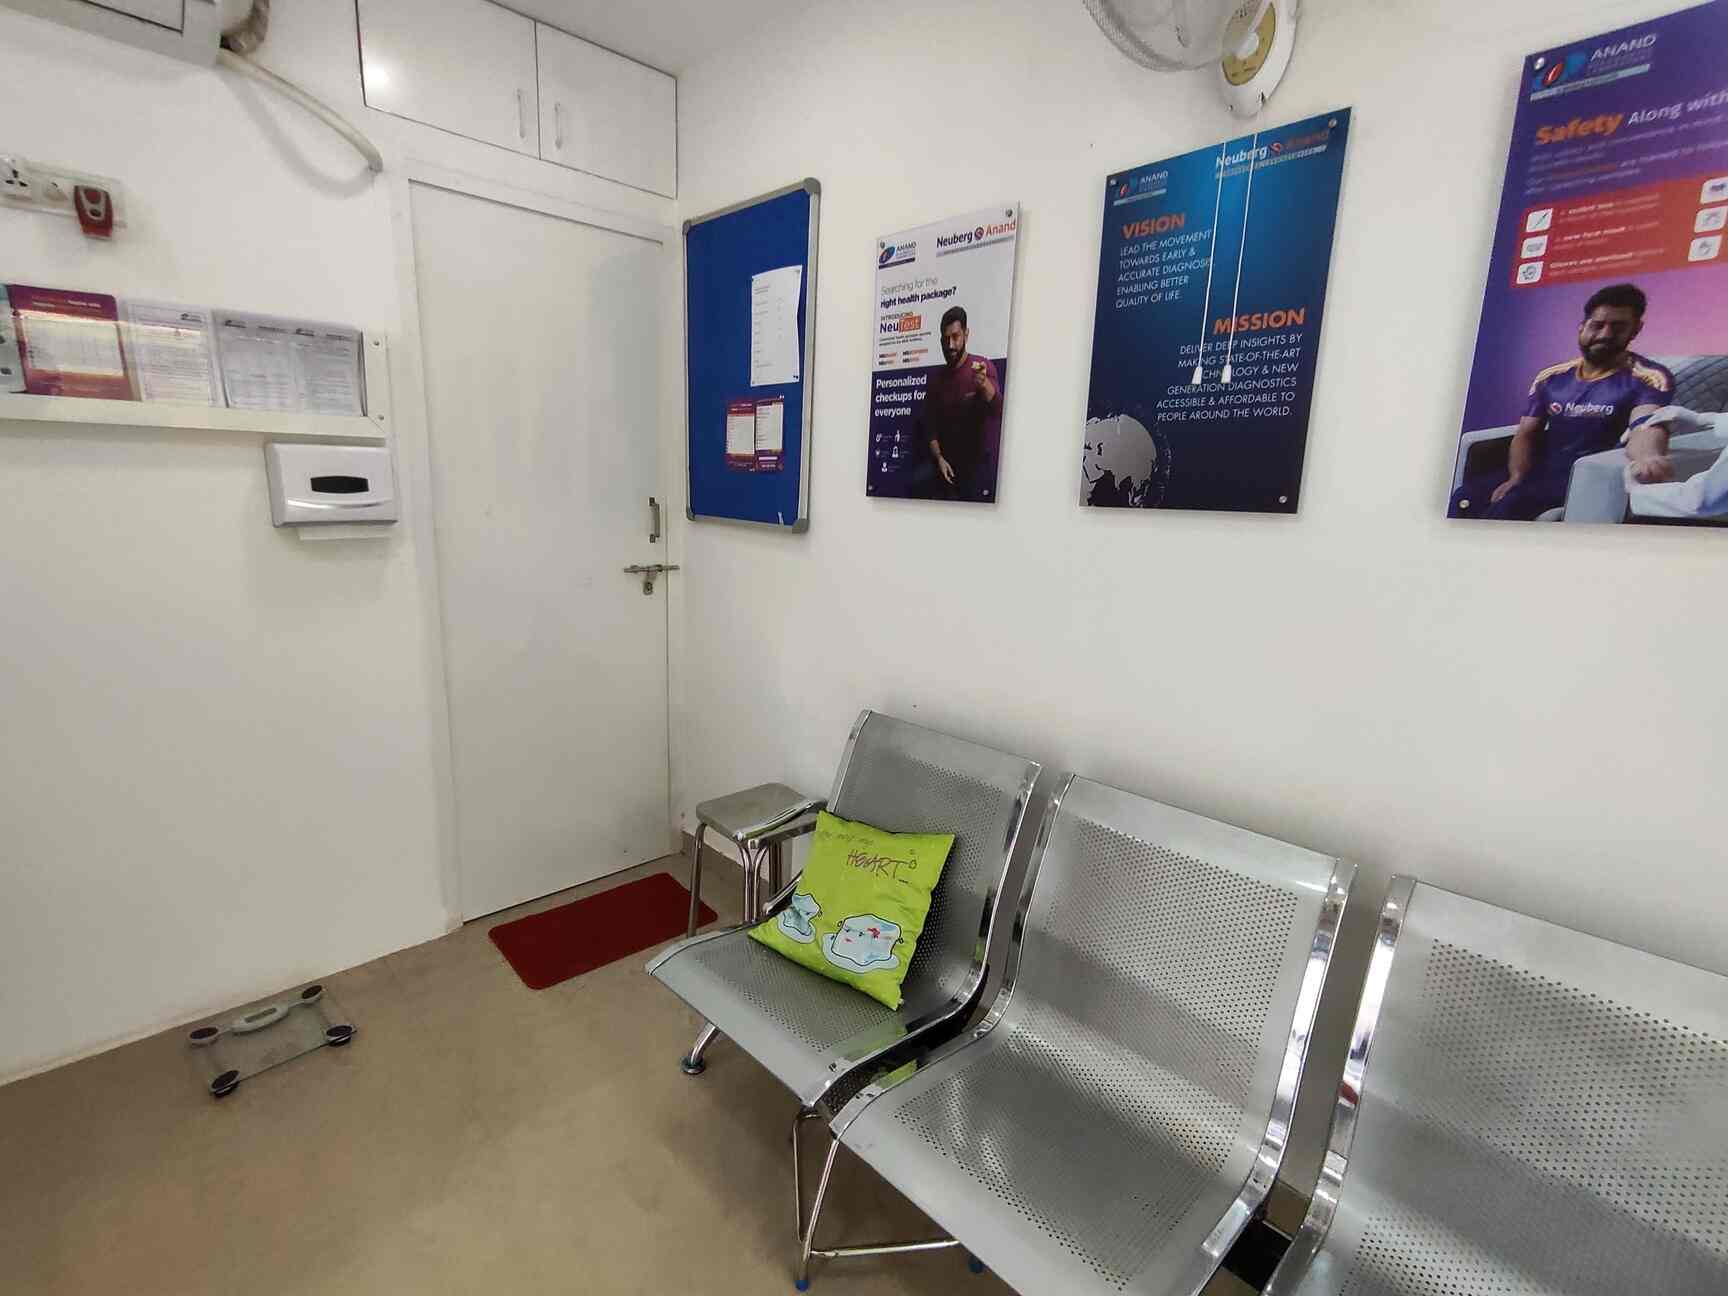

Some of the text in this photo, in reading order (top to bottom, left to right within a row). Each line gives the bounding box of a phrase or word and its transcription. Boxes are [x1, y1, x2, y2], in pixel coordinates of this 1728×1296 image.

[1535, 113, 1624, 144] Safety
[1627, 103, 1683, 127] Along
[936, 230, 974, 248] Neuberg
[985, 221, 1016, 237] Anand
[1122, 213, 1185, 240] VISION
[1120, 230, 1212, 257] LEAD THE MOVEMENT
[1120, 255, 1160, 269] TOWARDS
[1162, 249, 1189, 262] EARLY
[1118, 268, 1160, 282] ACCURATE
[1117, 275, 1190, 296] ENABLING BETTER
[881, 286, 957, 309] right health package?
[1115, 295, 1150, 309] QUALITY
[1151, 292, 1162, 303] OF
[1240, 335, 1286, 348] INSIGHTS
[1289, 333, 1302, 344] BY
[1178, 356, 1217, 368] MAKNG
[1262, 366, 1269, 376] &
[1272, 363, 1299, 374] NEW
[876, 374, 927, 389] Personalized
[1167, 377, 1297, 396] GENERATION DIAGNOSTICS
[875, 390, 927, 404] checkups for
[1156, 391, 1296, 409] ACCESSIBLE & AFFORDABLE TO
[874, 407, 911, 418] everyone
[1157, 411, 1187, 422] PEOPLE
[1189, 409, 1230, 421] AROUND
[1233, 408, 1249, 418] THE
[1564, 401, 1614, 415] Neuberg
